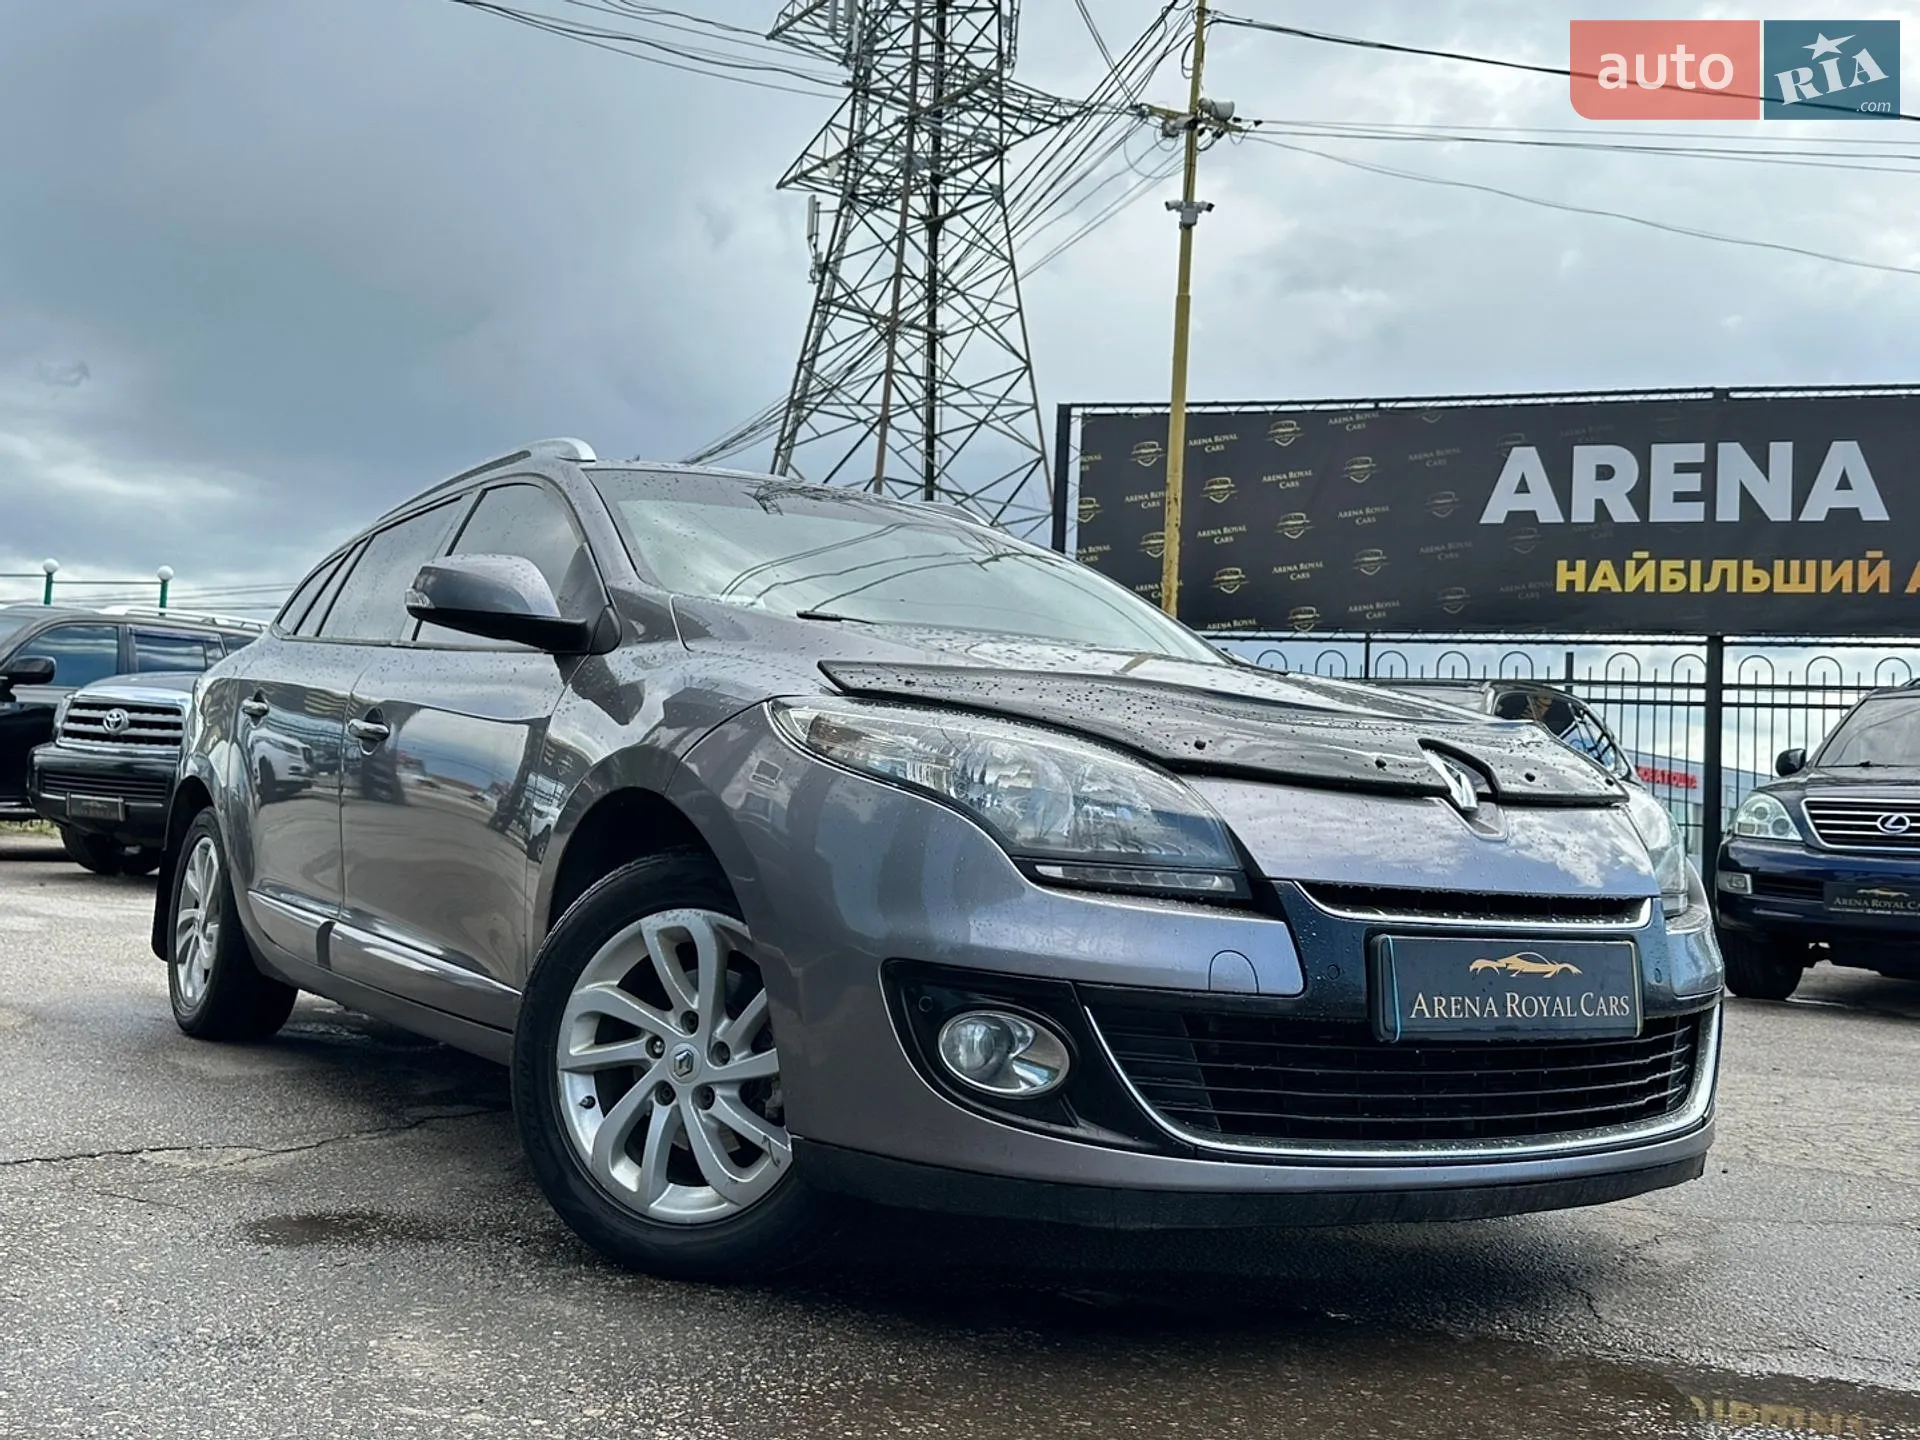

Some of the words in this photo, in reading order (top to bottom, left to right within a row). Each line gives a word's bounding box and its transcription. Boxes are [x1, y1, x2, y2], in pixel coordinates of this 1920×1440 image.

[1327, 416, 1354, 426] ARENA
[1344, 422, 1367, 433] CARS
[1188, 437, 1214, 448] ARENA
[1213, 432, 1239, 443] ROYAL
[1204, 443, 1225, 453] CARS
[1261, 472, 1288, 483] ARENA
[1288, 468, 1314, 479] ROYAL
[1277, 479, 1300, 490] CARS
[1479, 440, 1891, 524] ARENA
[1124, 493, 1150, 503] ARENA
[1141, 500, 1161, 510] CARS
[1337, 508, 1364, 518] ARENA
[1354, 515, 1377, 527] CARS
[1196, 529, 1222, 539] ARENA
[1222, 524, 1248, 535] ROYAL
[1212, 535, 1235, 545] CARS
[1271, 565, 1298, 575] ARENA
[1298, 560, 1324, 571] ROYAL
[1555, 550, 1891, 594] НАЙБІЛЬШИЙ
[1288, 571, 1312, 582] CARS
[1871, 898, 1906, 910] ROYAL
[1409, 992, 1499, 1019] ARENA
[1506, 992, 1577, 1018] ROYAL
[1580, 992, 1630, 1017] CARS
